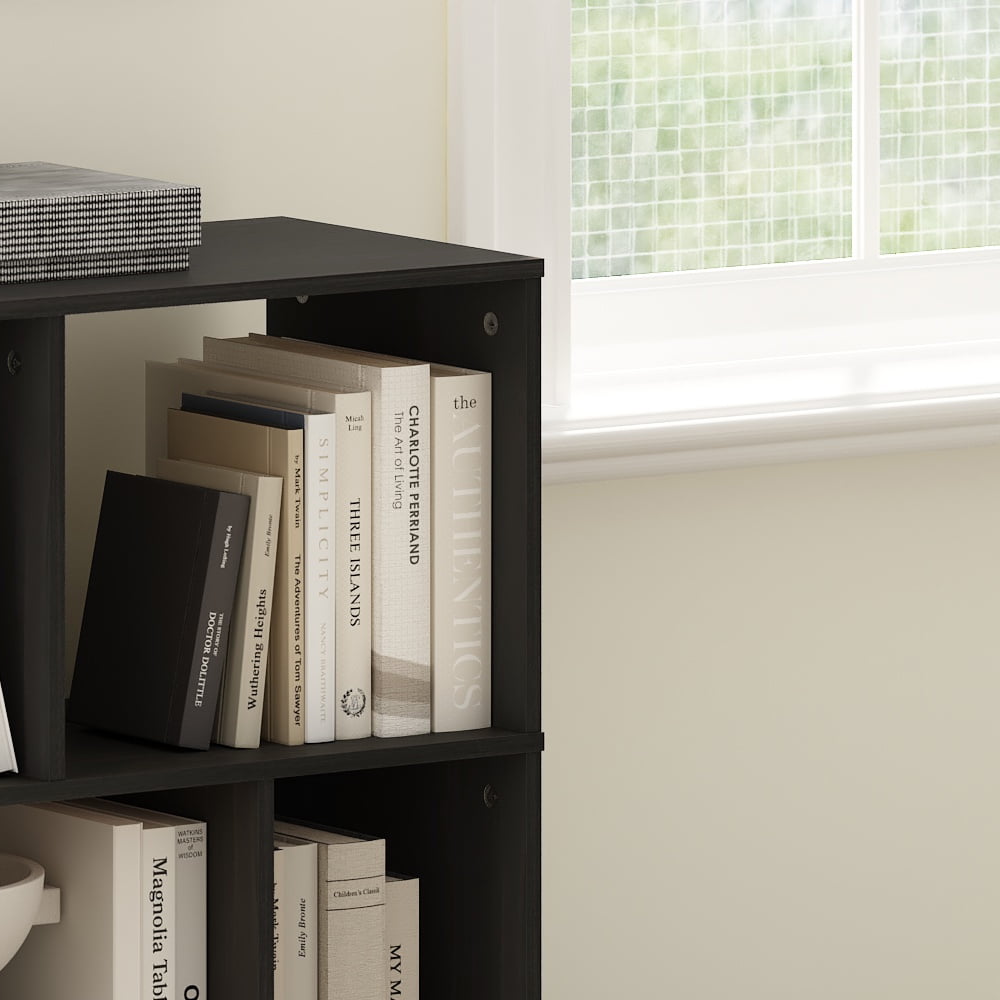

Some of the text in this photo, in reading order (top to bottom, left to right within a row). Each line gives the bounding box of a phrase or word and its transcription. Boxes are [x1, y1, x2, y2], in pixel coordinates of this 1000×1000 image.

[345, 414, 365, 423] Micah
[452, 395, 477, 410] the
[293, 454, 300, 464] by
[392, 411, 405, 510] The Art of Living
[408, 404, 420, 566] CHARLOTTE PERRIAND
[318, 436, 329, 601] SIMPLICITY
[348, 498, 362, 627] THREE ISLANDS
[451, 417, 483, 711] AUTHENTICS
[212, 647, 219, 656] OF
[214, 627, 222, 647] STORY
[248, 588, 268, 710] Wuthering Heights
[293, 554, 302, 727] The Adventures of Tom Sawyer
[319, 623, 327, 656] NANCY
[194, 611, 217, 707] DOCTOR DOLITTLE
[177, 828, 204, 837] WATKINS
[177, 836, 204, 845] MASTERS
[177, 851, 203, 859] WISDOM
[148, 857, 168, 953] Magnolia
[333, 889, 362, 898] Children's
[298, 897, 307, 958] Emily Bronte
[389, 944, 402, 975] MY
